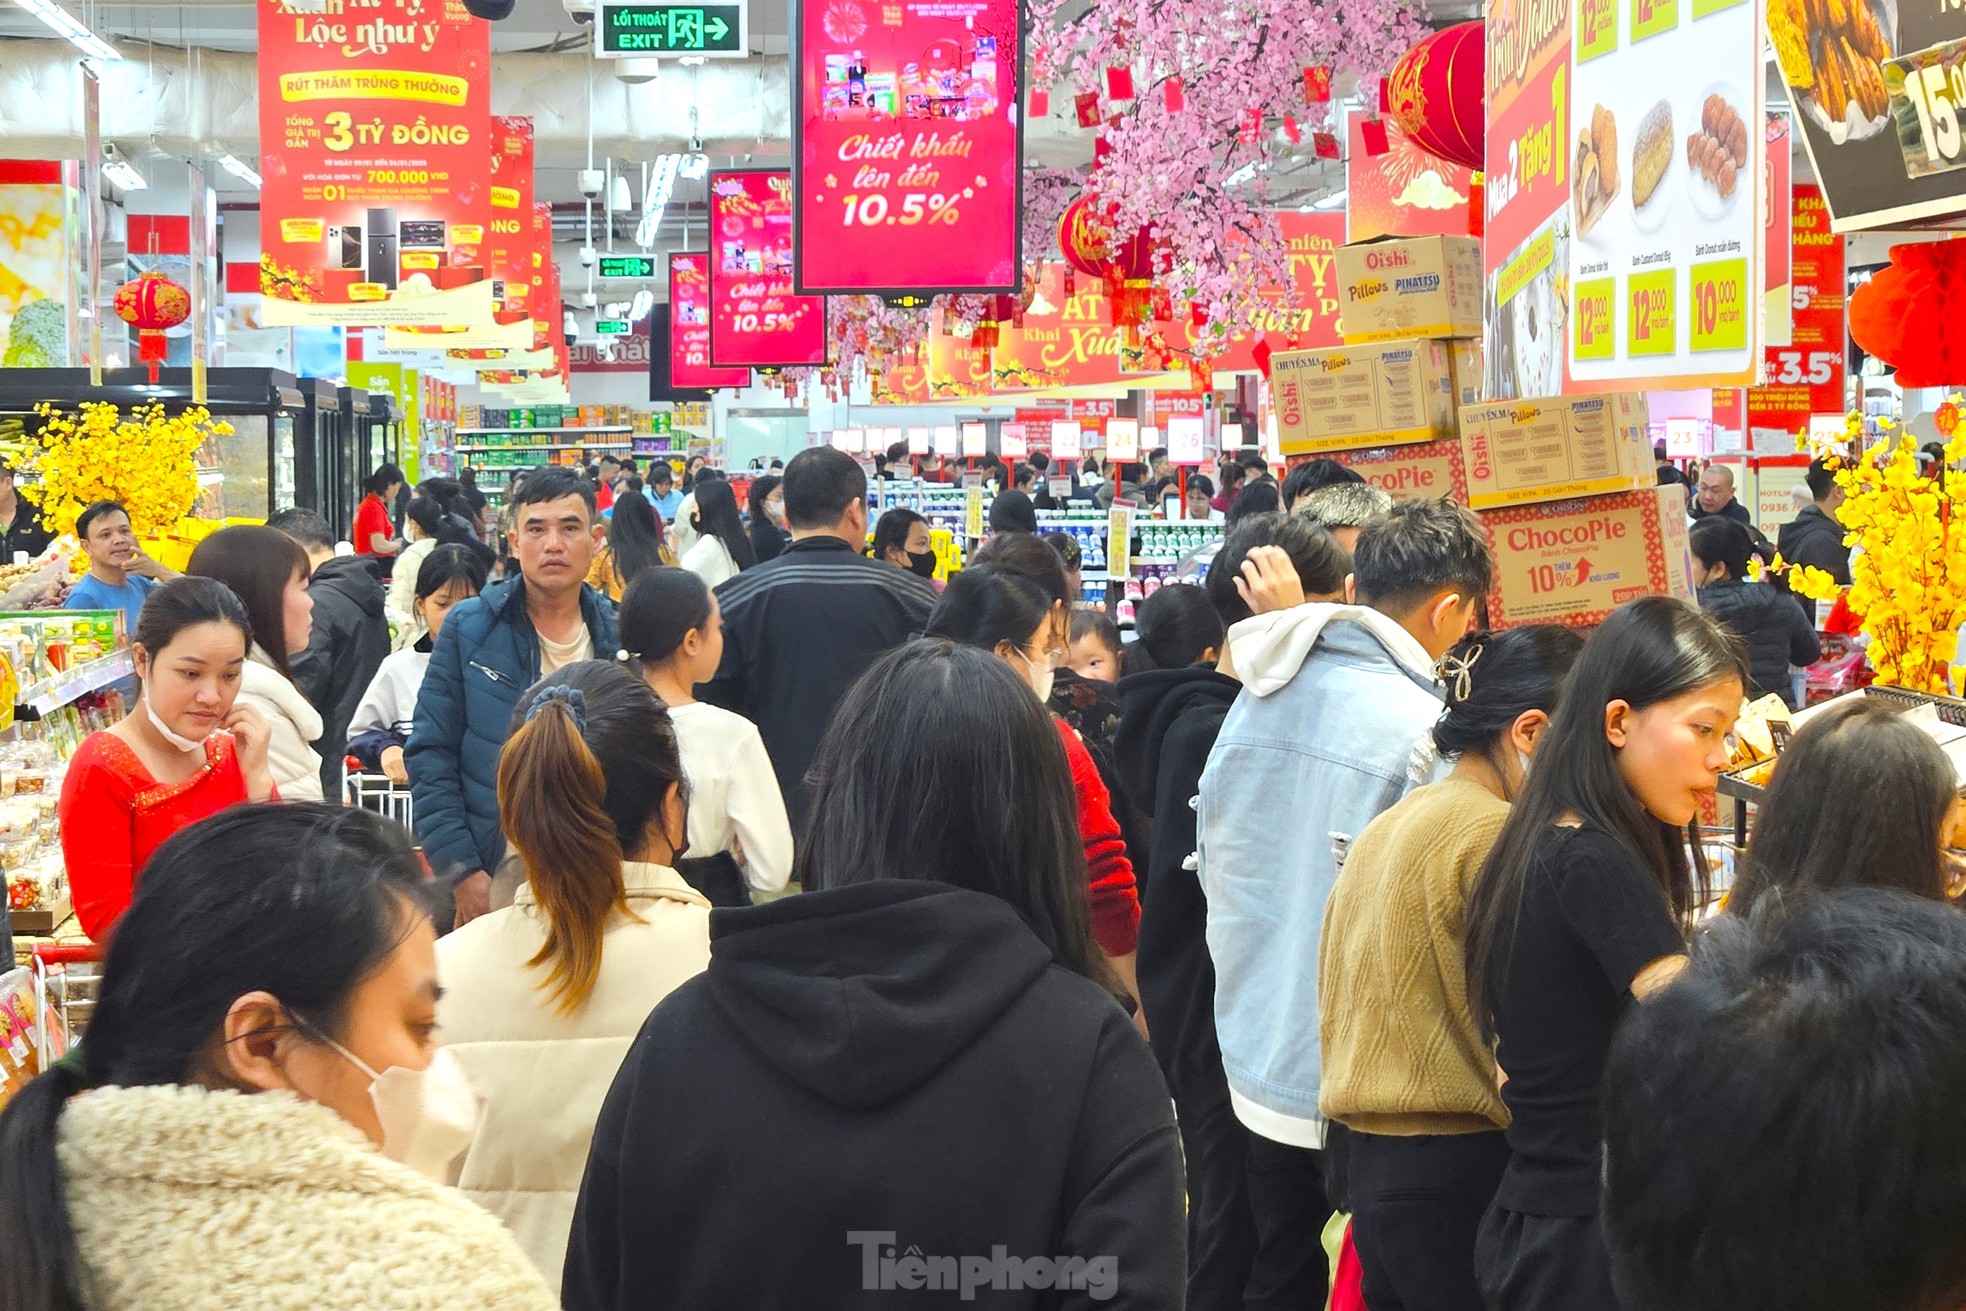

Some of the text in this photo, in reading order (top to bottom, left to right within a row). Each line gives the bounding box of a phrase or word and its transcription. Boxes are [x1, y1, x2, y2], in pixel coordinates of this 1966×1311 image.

[613, 9, 667, 26] LỐI THOÁT
[295, 17, 440, 57] Lộc như ý
[619, 34, 663, 48] EXIT
[286, 75, 460, 96] RÚT THĂM TRÚNG THƯỞNG
[323, 111, 354, 152] 3
[391, 114, 470, 145] ĐỒNG
[837, 131, 973, 161] Chiết khấu
[1488, 62, 1566, 223] Mua 2 Tặng 1
[367, 170, 428, 184] 700.000
[852, 162, 940, 189] lên đến
[323, 185, 346, 201] 01
[843, 193, 960, 226] 10.5%
[1291, 233, 1334, 250] niên
[1365, 250, 1409, 271] Oishi
[1348, 274, 1440, 302] Pillows PINATTSU
[1695, 280, 1737, 335] 10.000
[733, 313, 796, 333] 10.5%
[1024, 328, 1060, 341] Khai
[1321, 350, 1412, 372] Pillows PINATTSU
[1777, 351, 1842, 385] 3.5%
[1281, 381, 1302, 426] Oishi
[1510, 399, 1603, 424] Pillows PINATTSU
[1114, 433, 1131, 447] 24
[1181, 433, 1200, 448] 26
[1673, 432, 1692, 444] 23
[1471, 434, 1490, 480] Oishi
[1552, 503, 1585, 513] ORION
[1761, 503, 1789, 512] 0936
[1507, 517, 1626, 551] ChocoPie
[1562, 545, 1599, 556] ChocoPie
[1554, 561, 1571, 572] THÊM
[1527, 564, 1573, 594] 10%
